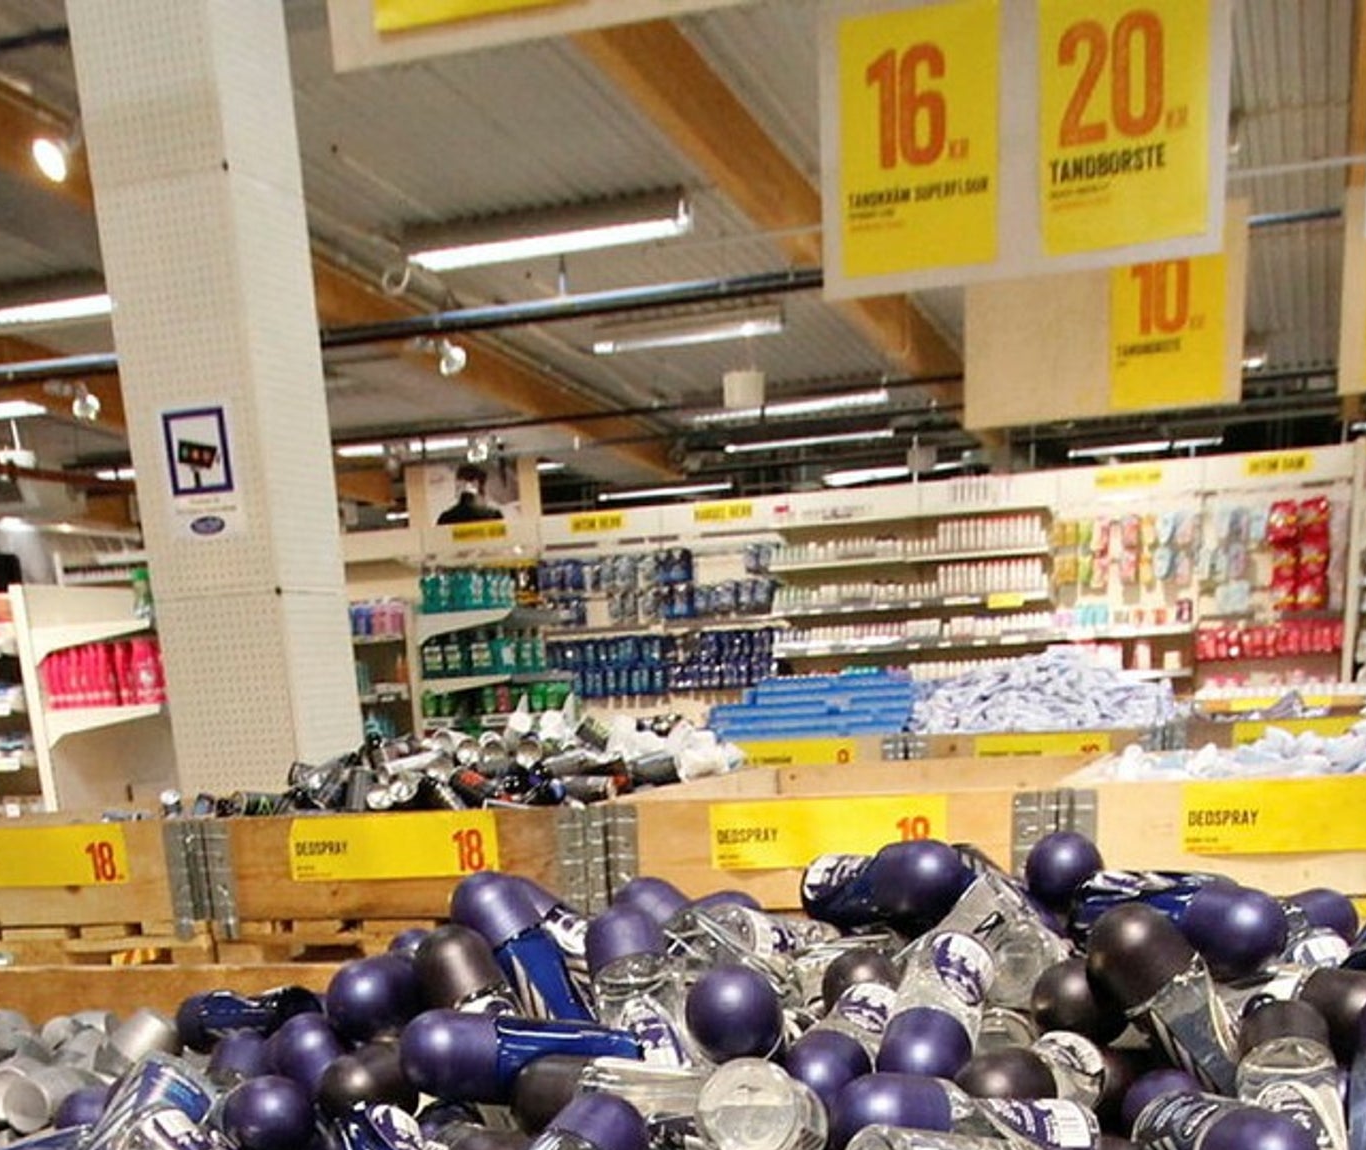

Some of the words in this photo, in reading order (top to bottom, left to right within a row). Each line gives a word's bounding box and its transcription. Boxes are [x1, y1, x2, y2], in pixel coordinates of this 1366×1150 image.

[1057, 9, 1164, 149] 20
[865, 42, 946, 170] 16
[1049, 143, 1166, 186] TANDBORSTE
[1129, 259, 1189, 336] 10
[716, 827, 779, 845] DEOSPRAY
[1187, 809, 1259, 828] DEOSPRAY
[85, 841, 117, 882] 18
[452, 828, 485, 871] 18
